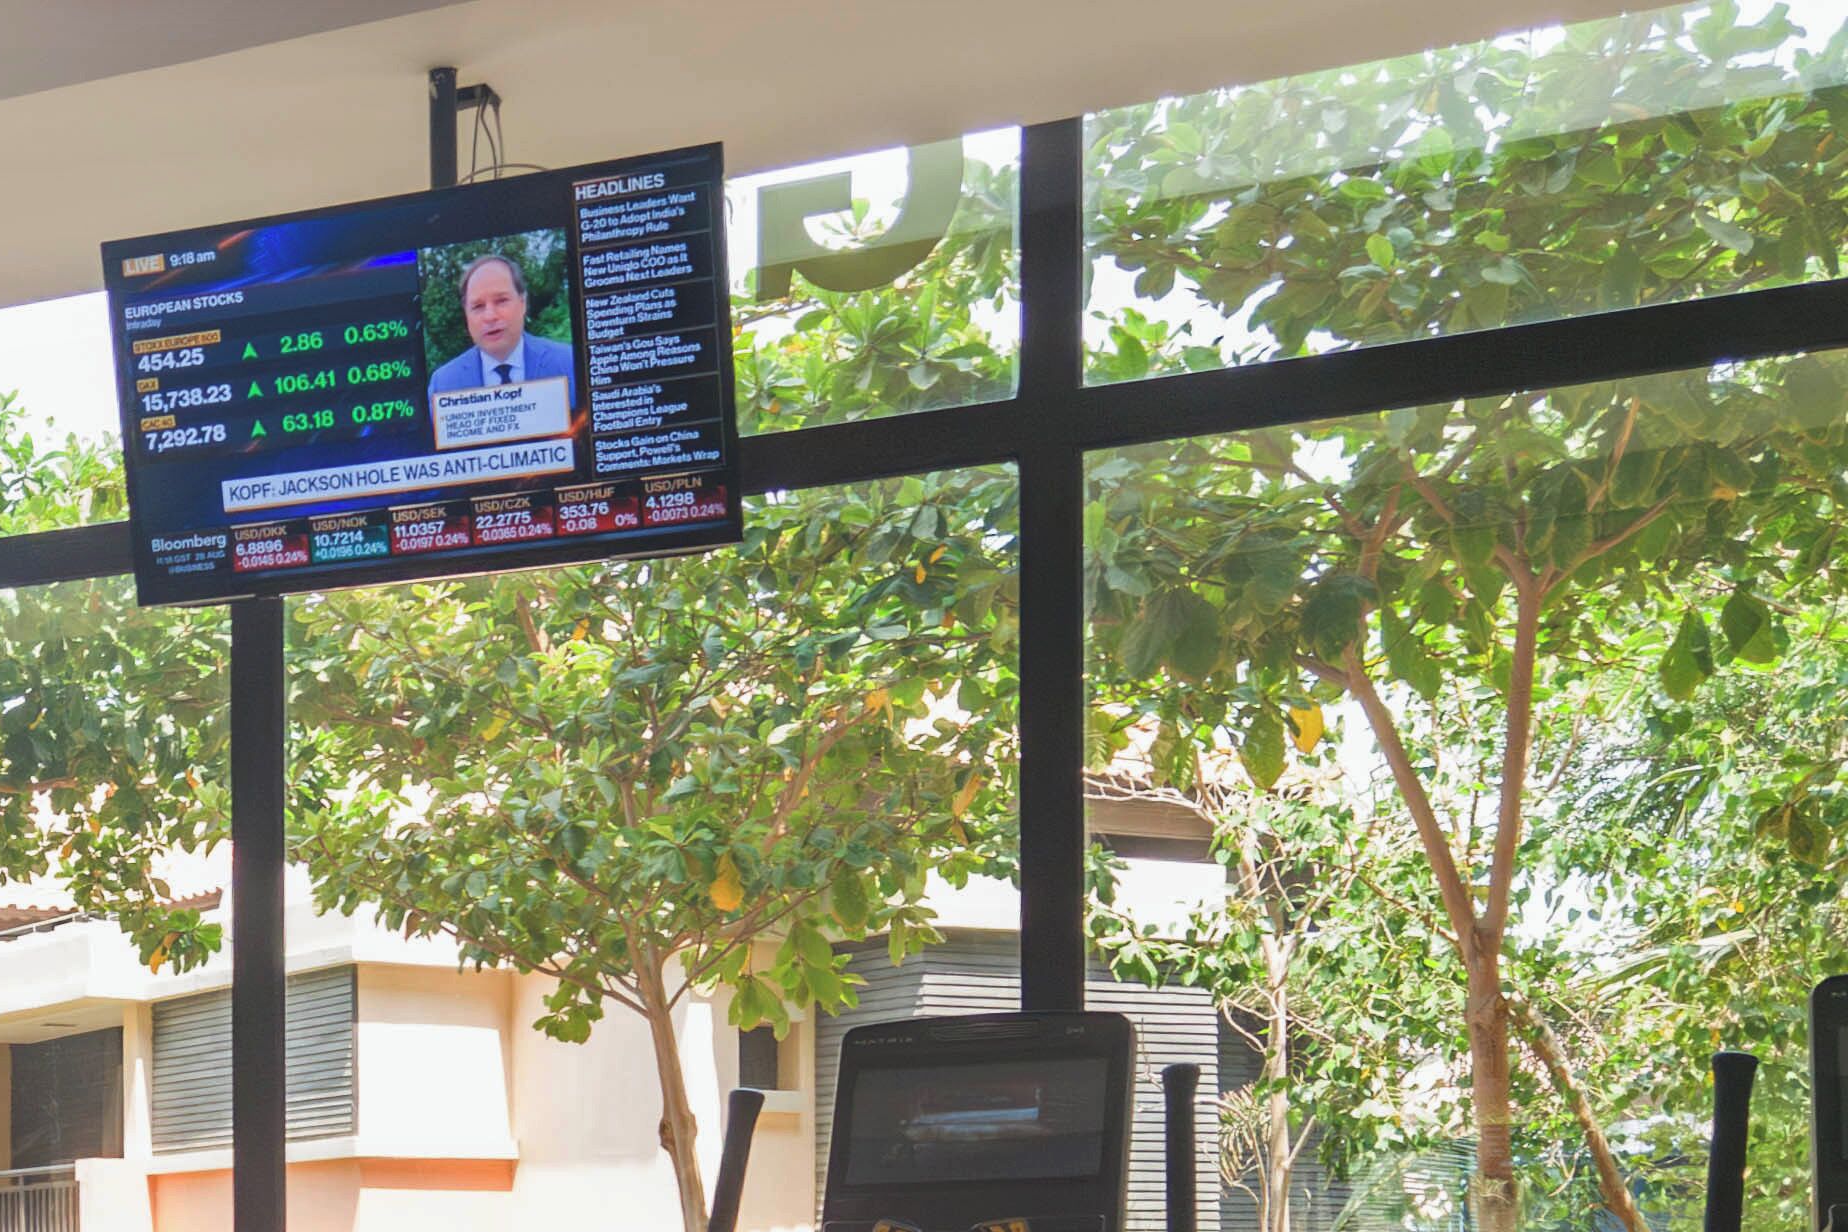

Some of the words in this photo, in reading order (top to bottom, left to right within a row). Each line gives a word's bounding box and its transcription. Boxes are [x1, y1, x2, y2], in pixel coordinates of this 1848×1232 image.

[575, 173, 665, 200] HEADLINES
[580, 204, 625, 219] Business
[626, 197, 668, 211] Leaders
[668, 192, 696, 204] Want
[581, 218, 607, 231] G-20
[608, 217, 619, 227] to
[620, 211, 650, 226] Adopt
[652, 206, 686, 219] India's
[582, 226, 645, 243] Philanthropy
[646, 221, 670, 233] Rule
[126, 255, 159, 273] LIVE
[169, 252, 195, 267] 9:18
[196, 251, 216, 263] am
[583, 254, 605, 266] Fast
[606, 248, 650, 262] Retailing
[650, 243, 687, 255] Names
[584, 267, 606, 277] New
[607, 261, 640, 273] Uniqlo
[640, 256, 666, 268] COO
[667, 256, 678, 264] as
[584, 275, 625, 288] Grooms
[626, 270, 650, 282] Next
[652, 264, 693, 278] Leaders
[125, 300, 191, 319] EUROPEAN
[193, 291, 244, 309] STOCKS
[586, 298, 609, 309] New
[610, 292, 650, 305] Zealand
[651, 288, 675, 299] Cuts
[586, 305, 634, 320] Spending
[635, 301, 663, 312] Plans
[664, 299, 677, 308] as
[126, 318, 162, 330] Intraday
[587, 316, 636, 330] Downturn
[637, 310, 673, 322] Strains
[588, 326, 624, 340] Budget
[138, 348, 205, 372] 454.25
[280, 332, 323, 354] 2.86
[344, 320, 408, 344] 0.63%
[589, 341, 632, 355] Taiwan's
[633, 339, 654, 350] Gou
[655, 335, 680, 347] Says
[590, 353, 619, 366] Apple
[620, 350, 656, 363] Among
[657, 343, 702, 356] Reasons
[590, 363, 619, 376] China
[620, 360, 649, 372] Won't
[650, 354, 695, 368] Pressure
[142, 384, 232, 413] 15,738.23
[275, 369, 335, 394] 106.41
[347, 360, 411, 384] 0.68%
[590, 376, 612, 386] Him
[439, 393, 491, 408] Christian
[494, 388, 522, 401] Kopf
[592, 389, 621, 402] Saudi
[621, 384, 662, 398] Arabia's
[445, 410, 475, 422] UNION
[477, 403, 536, 417] INVESTMENT
[593, 398, 643, 411] Interested
[644, 396, 654, 405] in
[593, 407, 649, 422] Champions
[650, 402, 688, 415] League
[145, 424, 226, 453] 7,292.78
[282, 410, 334, 432] 63.18
[352, 399, 414, 423] 0.87%
[446, 420, 472, 430] HEAD
[474, 418, 486, 427] OF
[489, 414, 516, 425] FIXED
[447, 427, 484, 439] INCOME
[486, 425, 505, 434] AND
[508, 423, 520, 431] FX
[594, 418, 634, 432] Football
[635, 415, 663, 427] Entry
[595, 438, 630, 452] Stocks
[631, 435, 654, 447] Gain
[655, 434, 669, 443] on
[669, 430, 700, 442] China
[639, 443, 681, 457] Powell's
[652, 452, 692, 465] Markets
[692, 449, 720, 461] Wrap
[229, 483, 276, 501] KOPF:
[279, 473, 352, 496] JACKSON
[356, 467, 400, 486] HOLE
[404, 462, 440, 481] WAS
[443, 446, 567, 475] ANTI-CLIMATIC
[645, 476, 702, 493] USD/PLN
[559, 486, 616, 503] USD/HUF
[646, 491, 694, 508] 4.1298
[392, 507, 447, 523] USD/SEK
[475, 498, 531, 513] USD/CZK
[560, 502, 609, 520] 353.76
[312, 516, 368, 532] USD/NOK
[394, 520, 445, 538] 11.0357
[476, 511, 531, 529] 22.2775
[562, 518, 597, 531] -0.08
[615, 512, 638, 526] 0%
[152, 534, 227, 552] Bloomberg
[234, 526, 287, 541] USD/DKK
[314, 530, 364, 547] 10.7214
[236, 539, 283, 556] 6.8896
